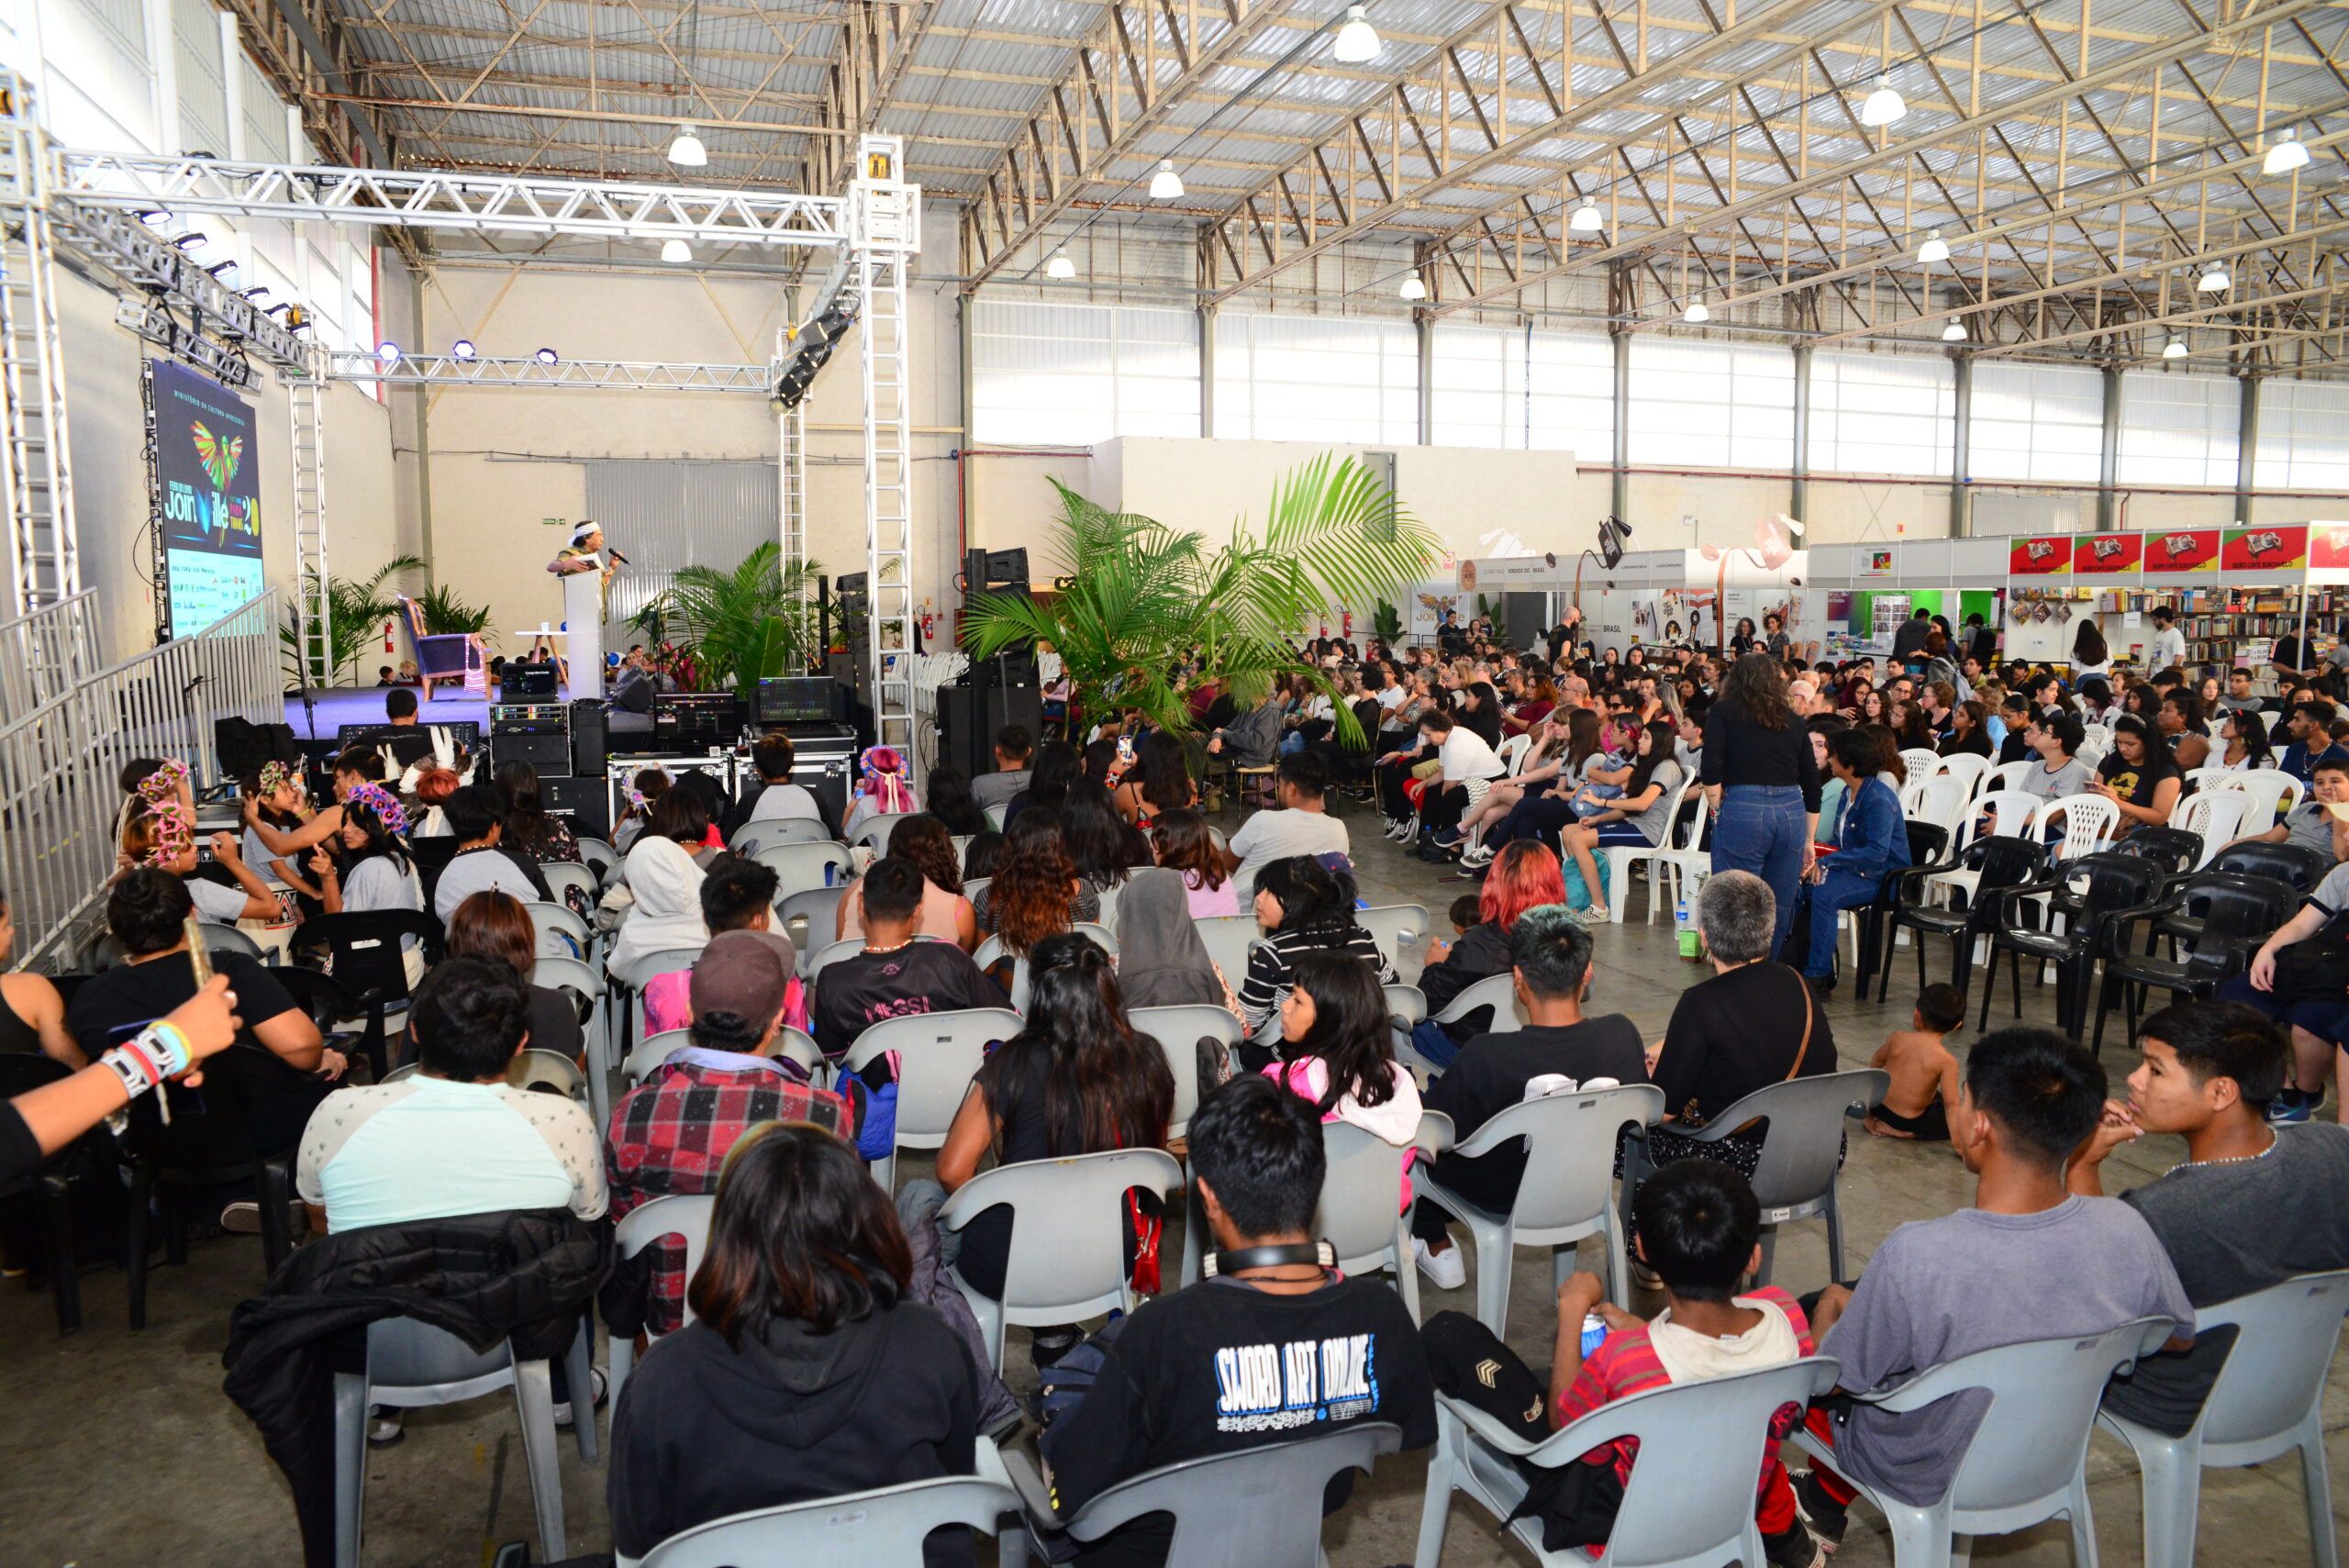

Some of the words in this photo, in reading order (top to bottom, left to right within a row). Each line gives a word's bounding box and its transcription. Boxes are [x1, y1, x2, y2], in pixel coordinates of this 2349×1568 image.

[1603, 625, 1621, 633] BRASIL
[864, 995, 930, 1024] MESSI
[1214, 1343, 1282, 1415] SWORD
[1282, 1340, 1318, 1410] ART
[1319, 1333, 1370, 1405] ONLINE
